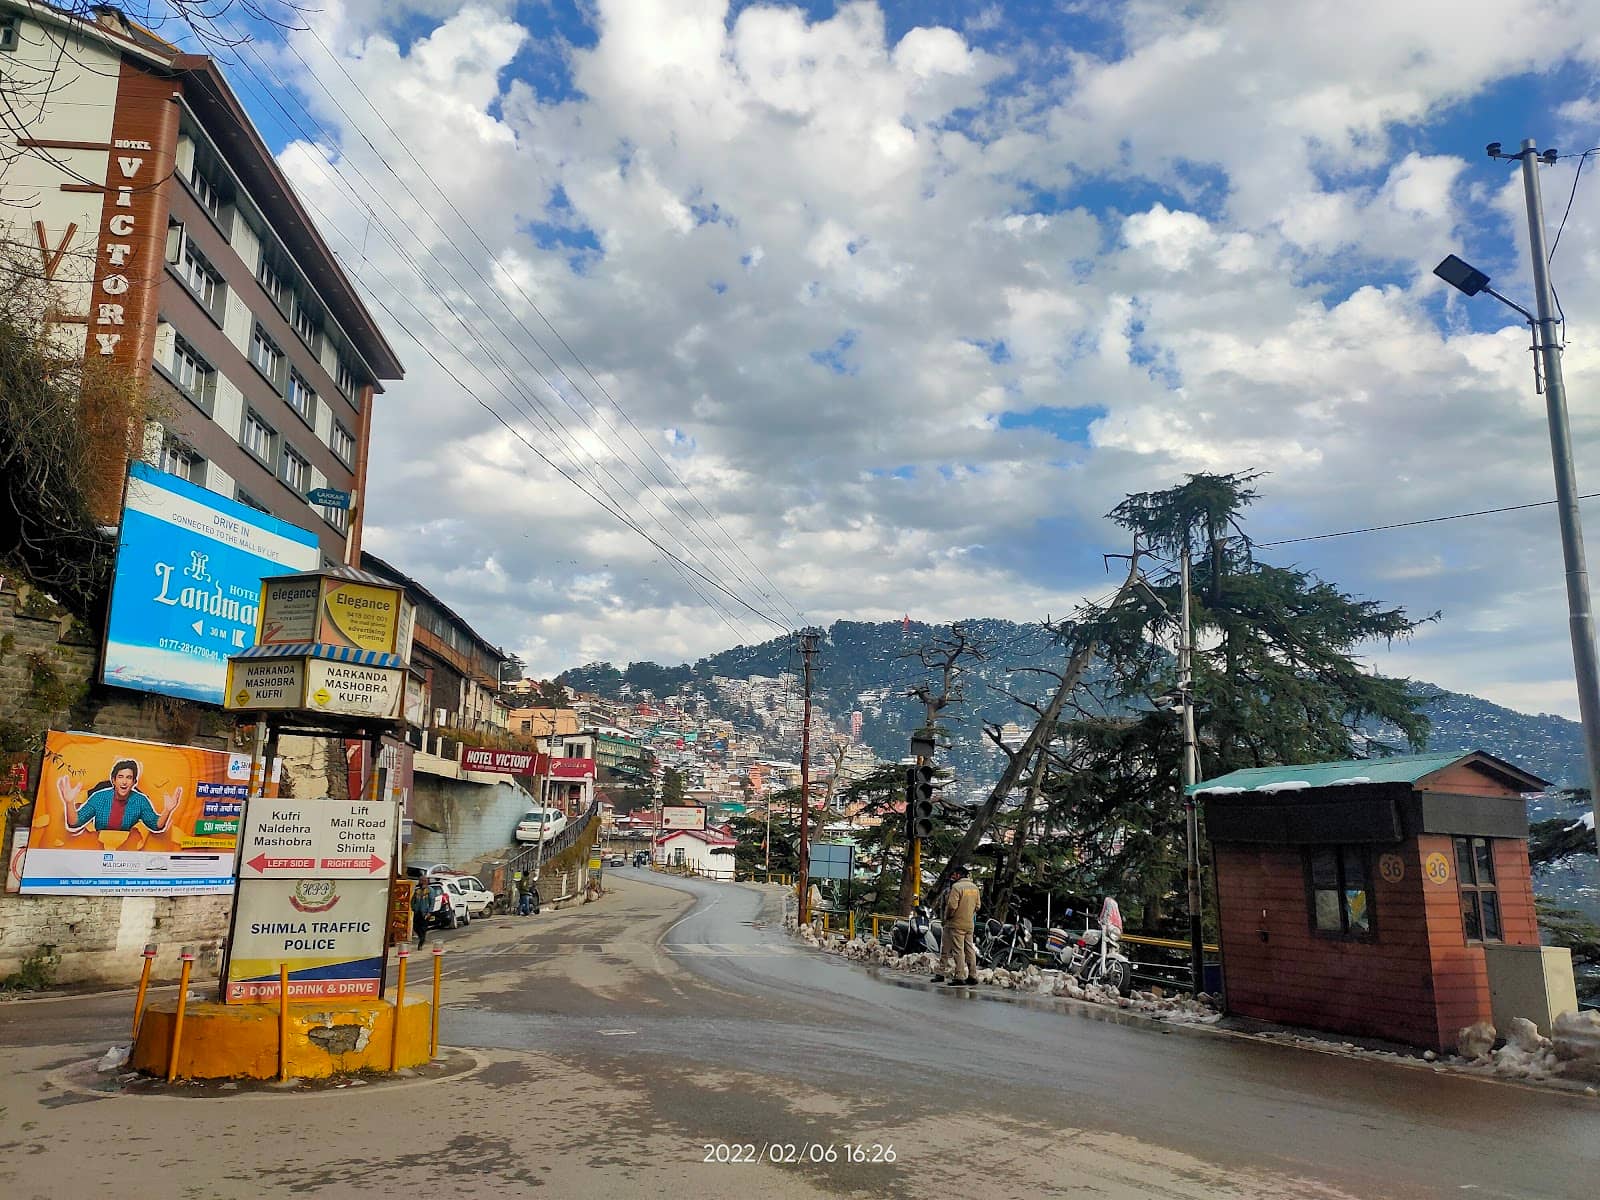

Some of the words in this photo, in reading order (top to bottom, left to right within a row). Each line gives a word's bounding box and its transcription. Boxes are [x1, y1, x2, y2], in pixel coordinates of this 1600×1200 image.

[115, 139, 151, 150] HOTEL
[96, 157, 143, 355] VICTORY
[213, 515, 239, 533] DRIVE
[241, 526, 250, 537] IN
[172, 513, 215, 535] CONNECTED
[216, 530, 225, 539] TO
[225, 533, 238, 544] THE
[239, 538, 256, 551] MALL
[257, 545, 267, 553] BY
[267, 549, 279, 560] LIFT
[229, 584, 259, 602] HOTEL
[272, 588, 318, 602] elegance
[336, 593, 390, 611] Elegance
[348, 626, 386, 636] advertising
[357, 633, 385, 642] printing
[247, 665, 295, 676] NARKANDA
[327, 667, 389, 682] NARKANDA
[245, 677, 295, 688] MASHOBRA
[325, 679, 388, 693] MASHOBRA
[255, 689, 282, 699] KUFRI
[339, 692, 372, 703] KUFRI
[466, 750, 493, 766] HOTEL
[495, 753, 532, 769] VICTORY
[272, 811, 301, 821] Kufri
[351, 806, 369, 815] Lift
[258, 823, 311, 834] Naldehra
[330, 818, 354, 827] Mall
[357, 819, 386, 828] Road
[254, 836, 312, 846] Mashobra
[339, 831, 376, 841] Chotta
[337, 843, 375, 853] Shimla
[267, 859, 289, 867] LEFT
[290, 860, 310, 868] SIDE
[327, 859, 353, 868] RIGHT
[353, 860, 372, 868] SIDE
[1382, 861, 1401, 877] 36
[1430, 862, 1447, 878] 36
[251, 923, 307, 934] SHIMLA
[312, 922, 371, 933] TRAFFIC
[284, 939, 336, 951] POLICE
[288, 983, 324, 995] DRINK
[327, 984, 336, 993] &
[339, 983, 373, 993] DRIVE
